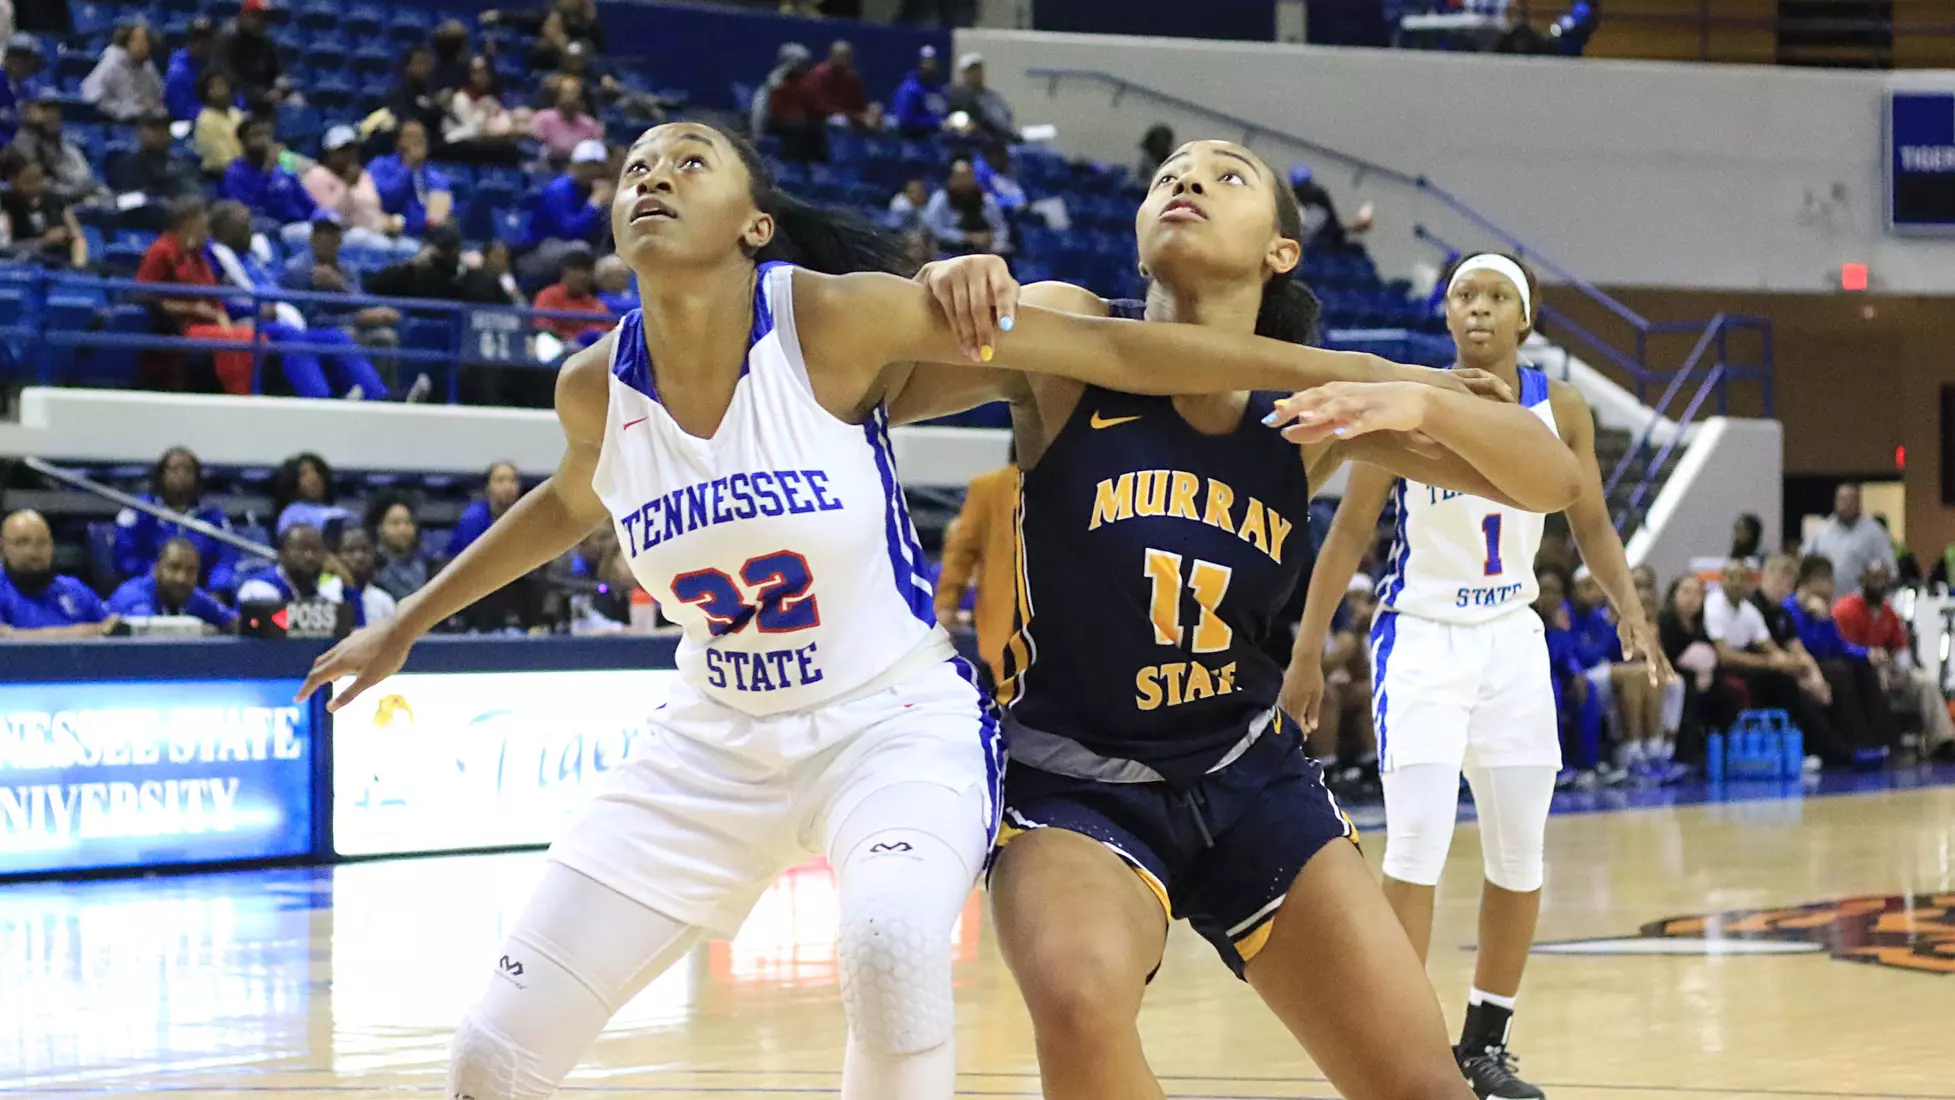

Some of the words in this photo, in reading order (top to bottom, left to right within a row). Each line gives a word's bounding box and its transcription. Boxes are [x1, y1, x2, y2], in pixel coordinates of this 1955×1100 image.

[621, 470, 844, 558] TENNESSEE
[1089, 469, 1293, 564] MURRAY
[1481, 512, 1503, 577] 1
[286, 603, 337, 630] POSS
[670, 549, 821, 636] 32
[1144, 547, 1232, 653] 11
[707, 641, 823, 692] STATE
[168, 706, 301, 763] STATE
